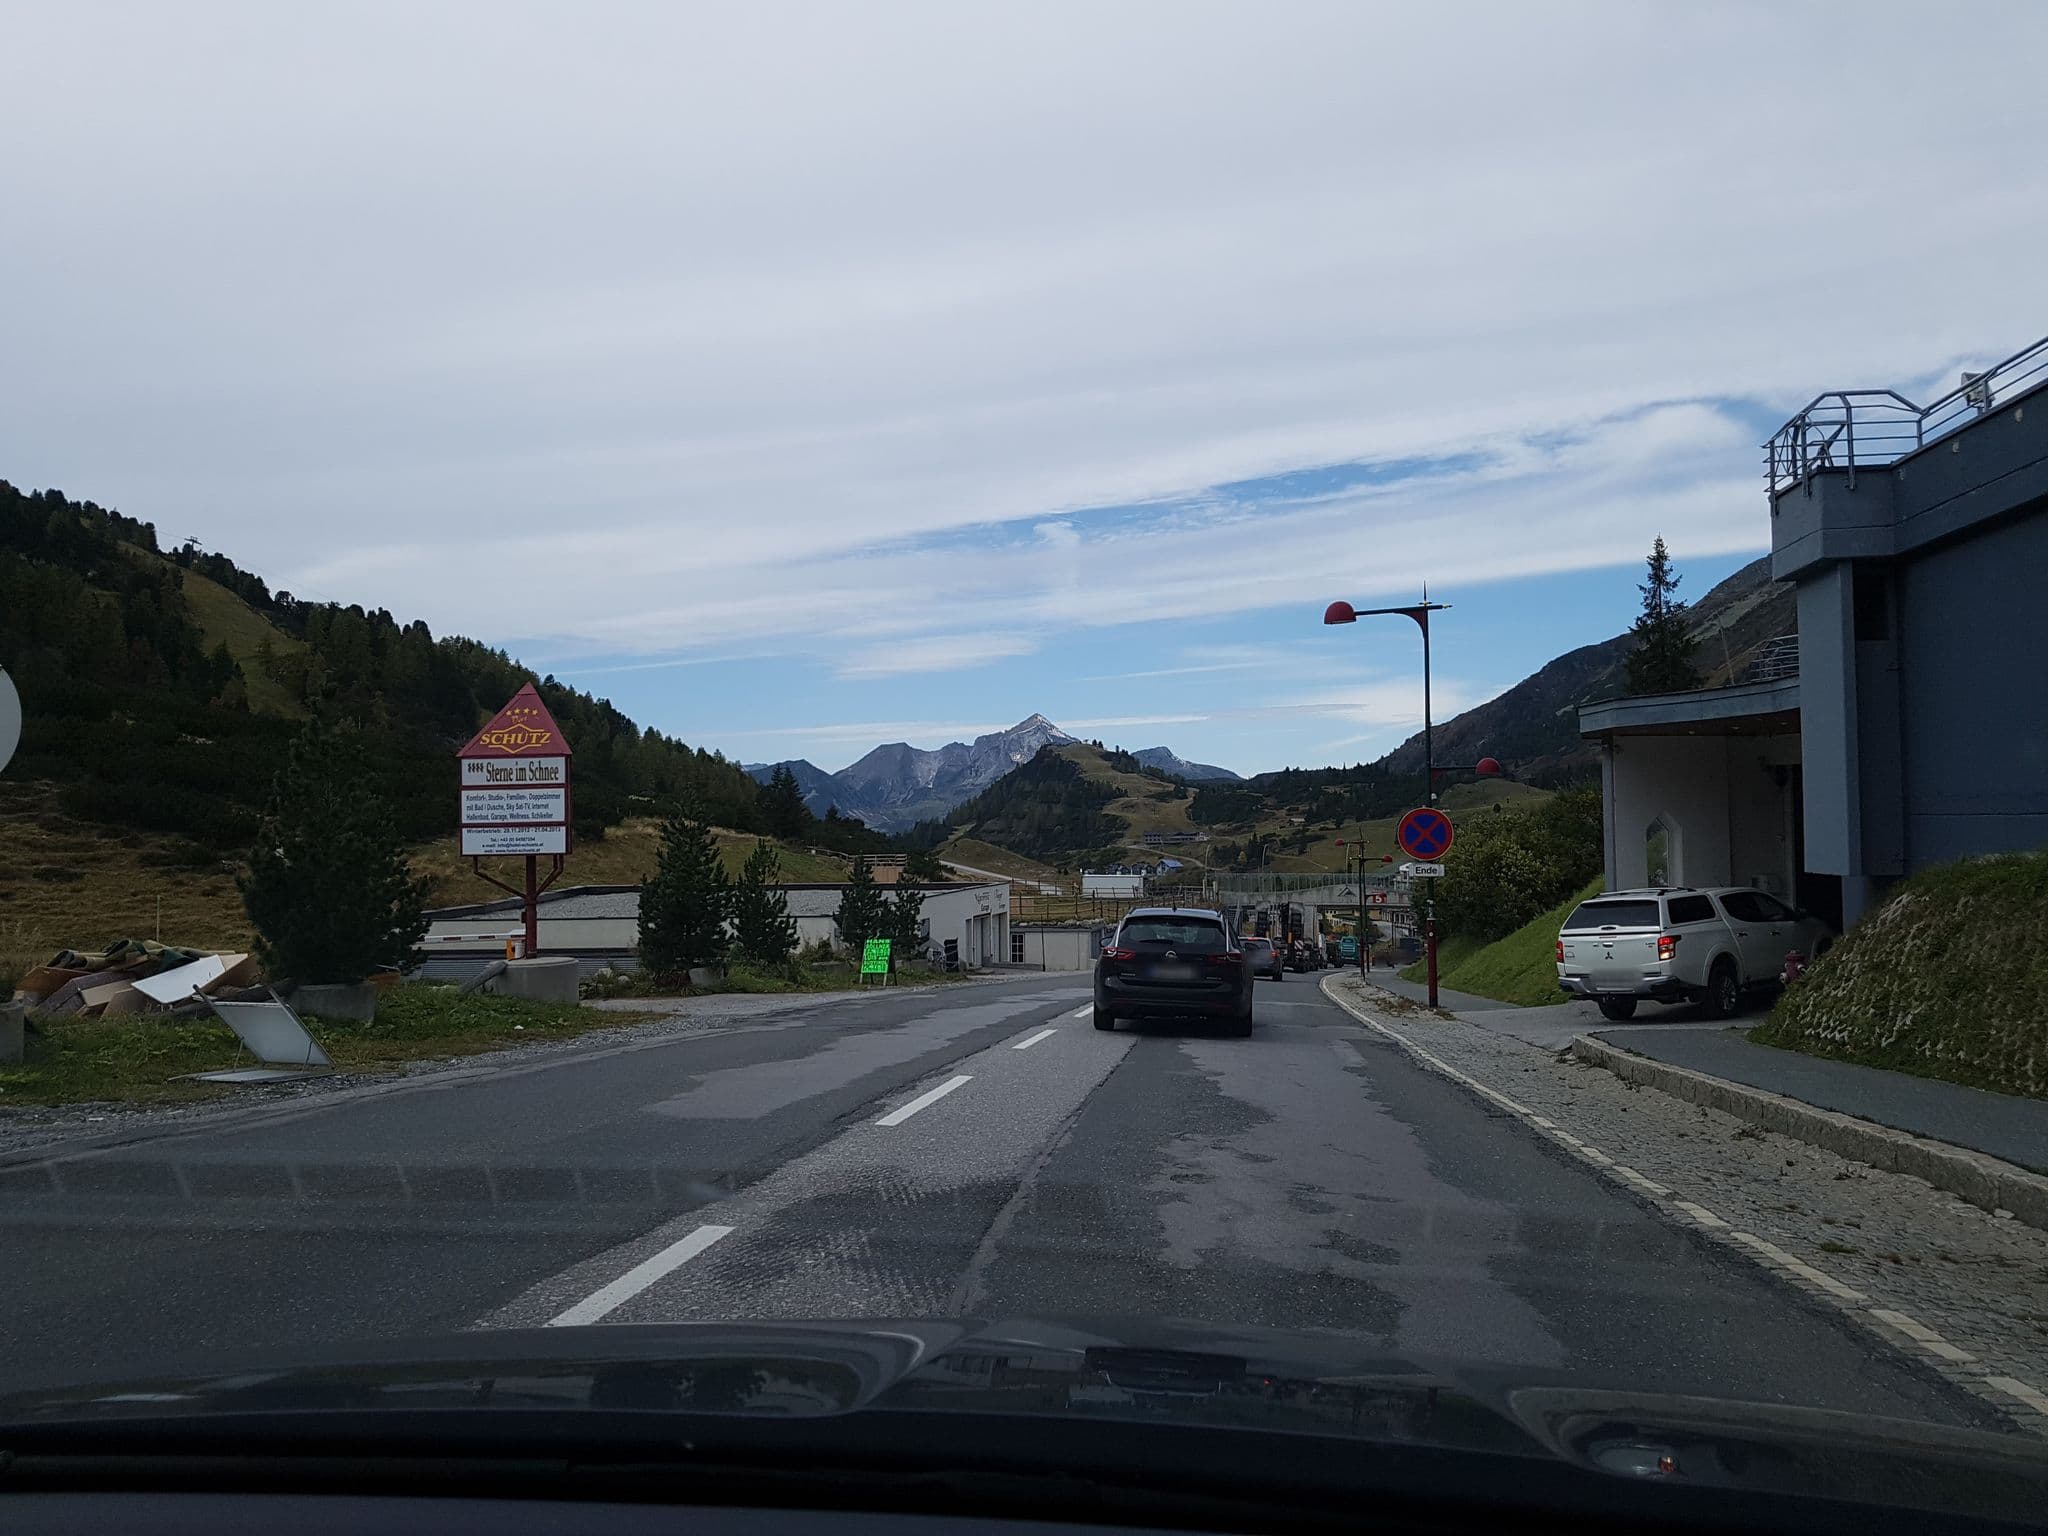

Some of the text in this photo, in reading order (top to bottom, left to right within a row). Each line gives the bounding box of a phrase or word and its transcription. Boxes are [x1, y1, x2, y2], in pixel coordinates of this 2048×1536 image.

[486, 760, 559, 782] Sterne im Schnee
[529, 792, 560, 801] Doppelzimmer
[474, 803, 483, 811] Bad
[506, 803, 515, 812] Sky
[531, 802, 549, 810] Internet
[1415, 866, 1438, 874] Ende
[1375, 895, 1382, 903] 5
